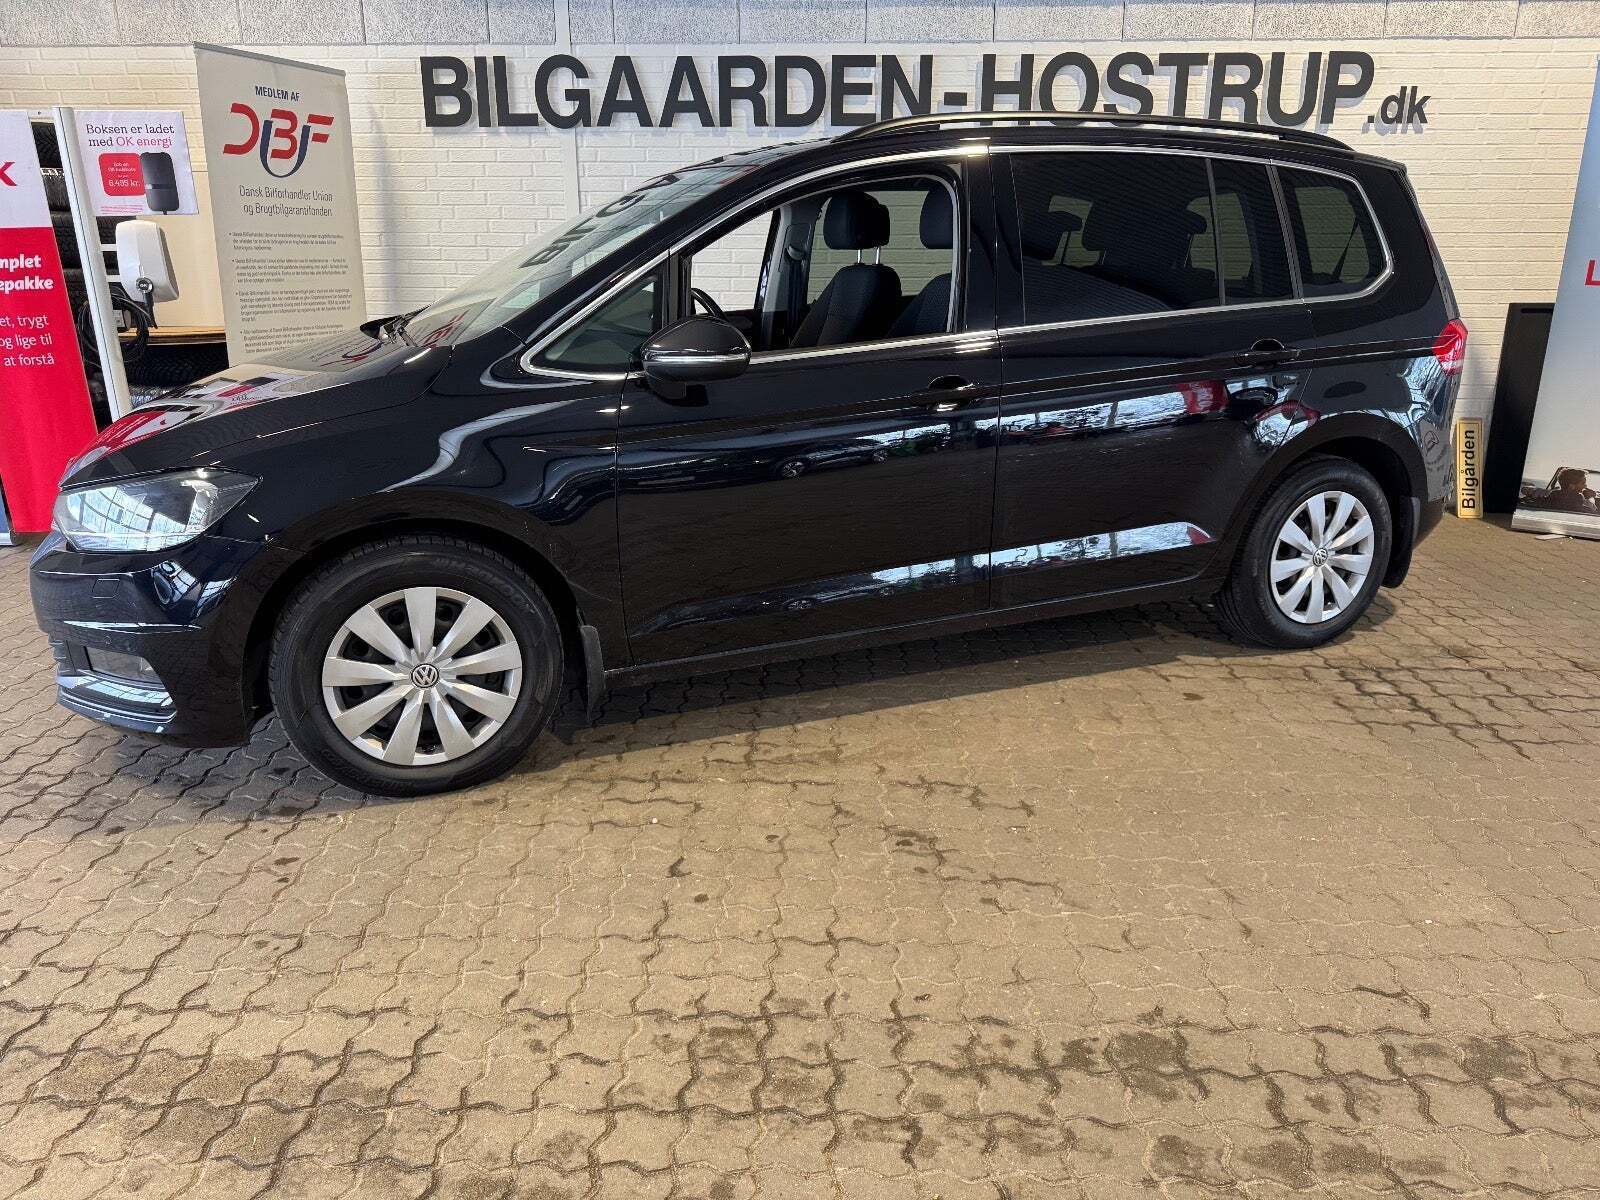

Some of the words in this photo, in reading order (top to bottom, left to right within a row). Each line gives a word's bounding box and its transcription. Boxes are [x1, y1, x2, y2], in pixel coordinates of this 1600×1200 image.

[255, 86, 289, 100] MEDLEM
[290, 91, 301, 101] AF
[86, 124, 128, 134] Boksen
[144, 124, 175, 134] ladet
[88, 137, 113, 147] med
[116, 137, 134, 146] OK
[136, 137, 173, 149] energi
[240, 185, 263, 197] Dansk
[265, 187, 311, 200] Bilforhandler
[312, 190, 333, 202] Union
[243, 204, 254, 216] og
[17, 315, 49, 329] trygt
[15, 334, 37, 349] lige
[40, 333, 52, 345] til
[4, 356, 17, 366] at
[18, 353, 55, 366] forstå
[1461, 429, 1478, 509] Bilgården
